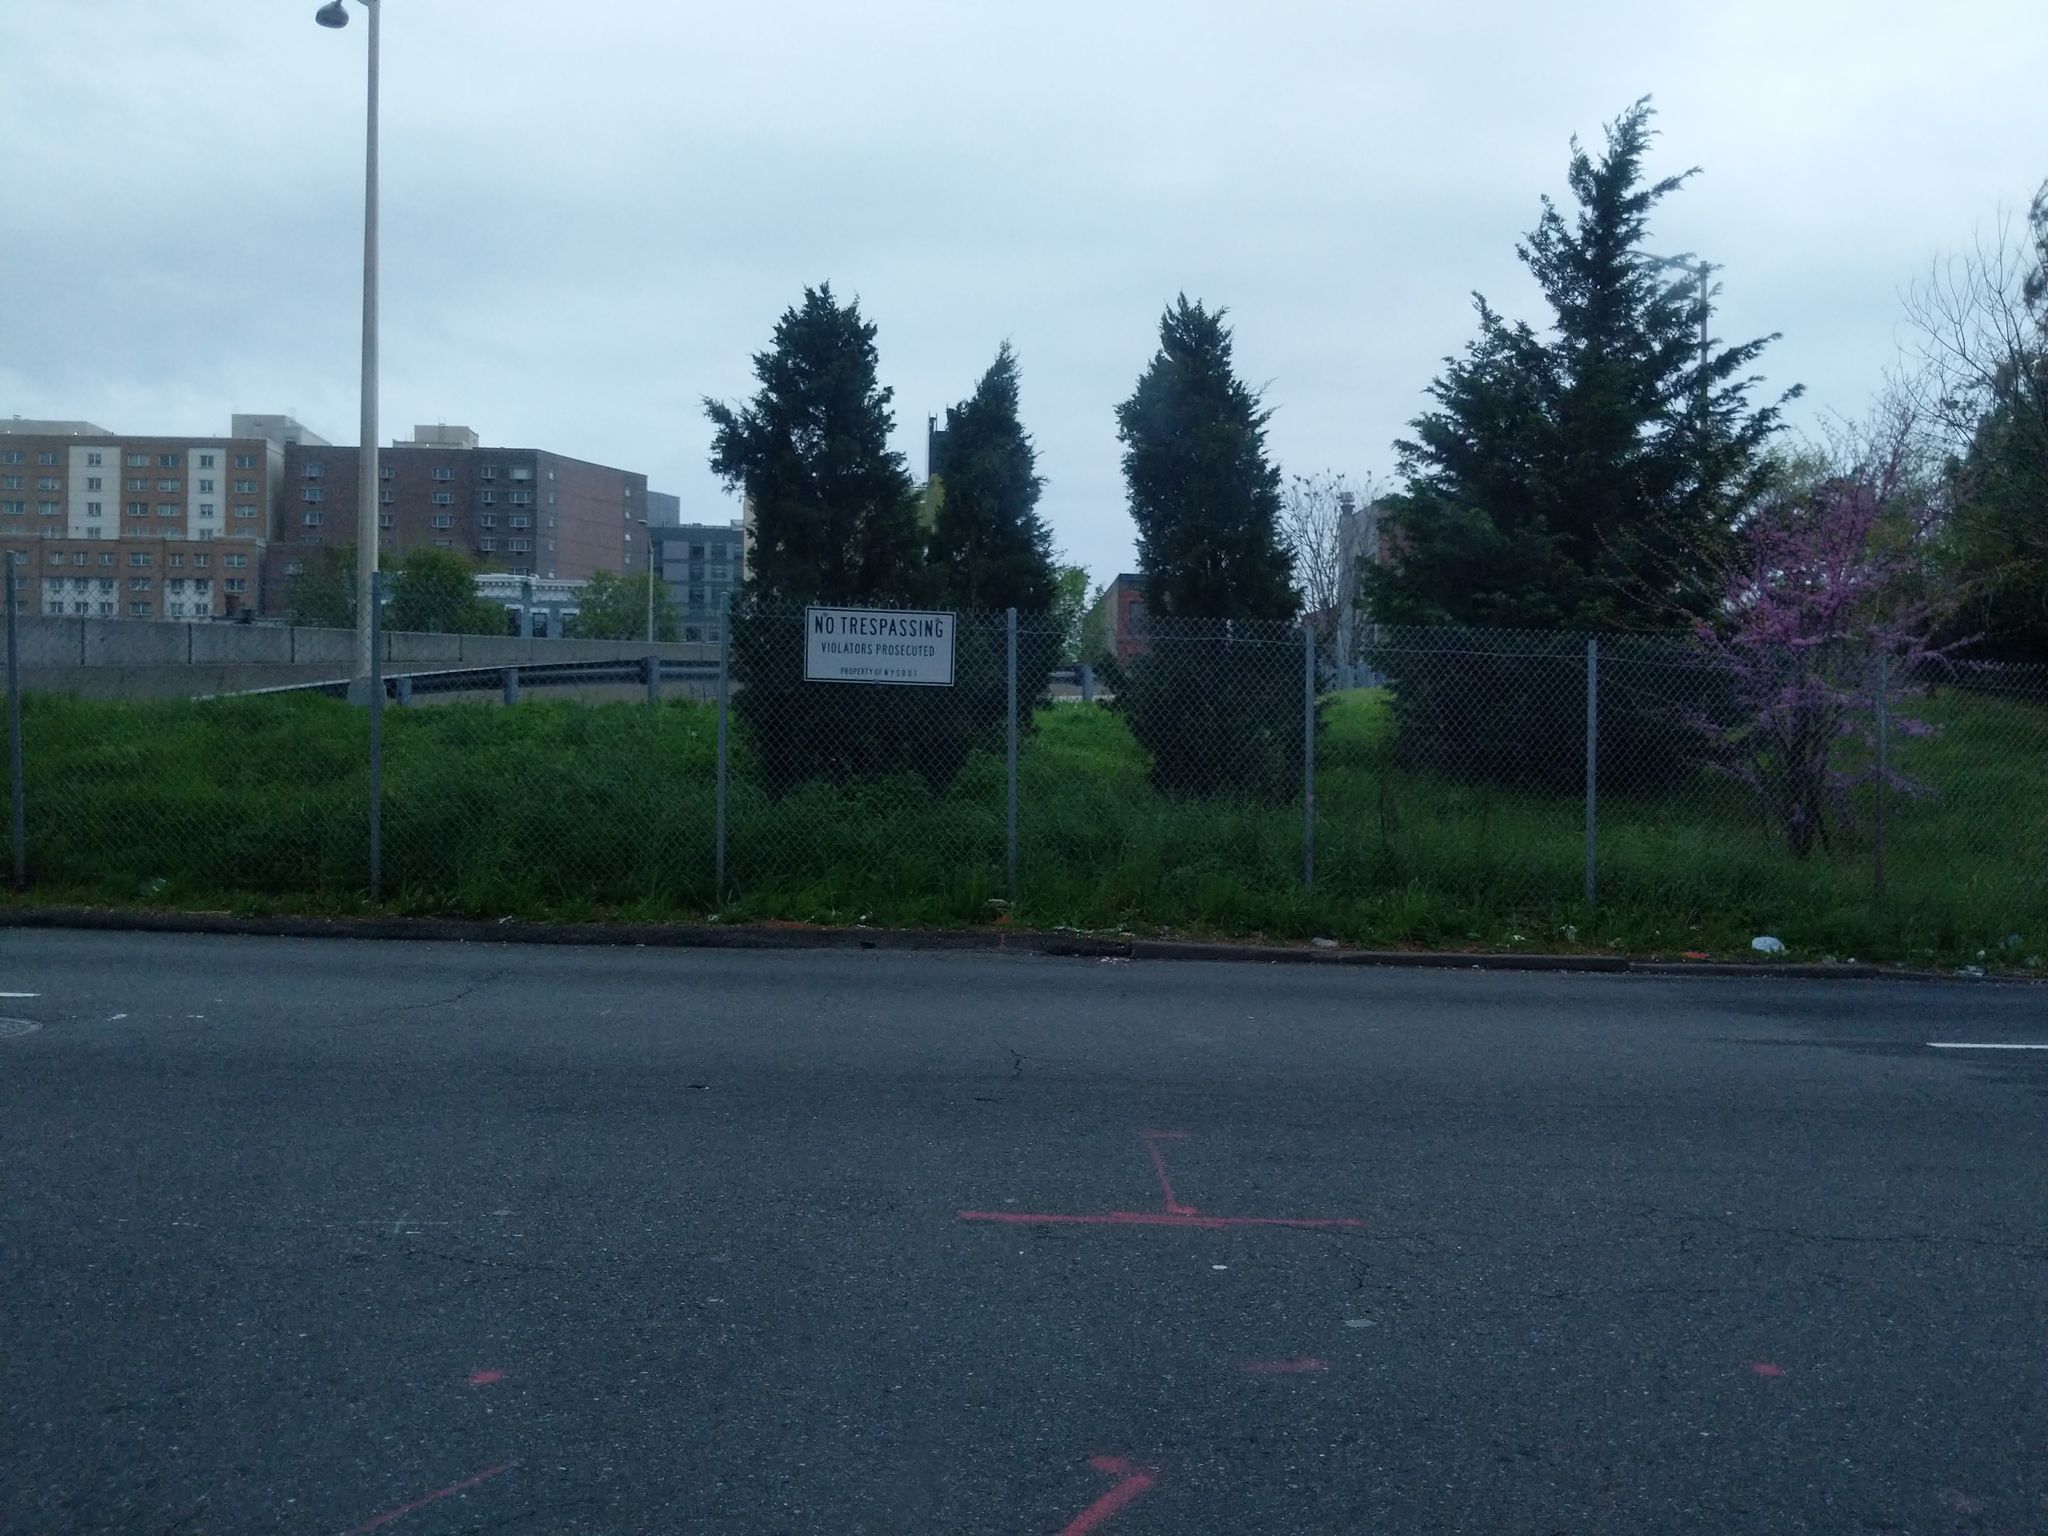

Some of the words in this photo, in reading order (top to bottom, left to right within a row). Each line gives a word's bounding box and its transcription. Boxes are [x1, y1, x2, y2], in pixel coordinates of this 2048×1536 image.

[814, 616, 835, 634] NO
[841, 617, 944, 638] TRESPASSING
[821, 642, 873, 655] VIOLATORS
[876, 644, 935, 657] PROSECUTED
[840, 667, 873, 676] PROPERTY
[874, 667, 882, 677] OF
